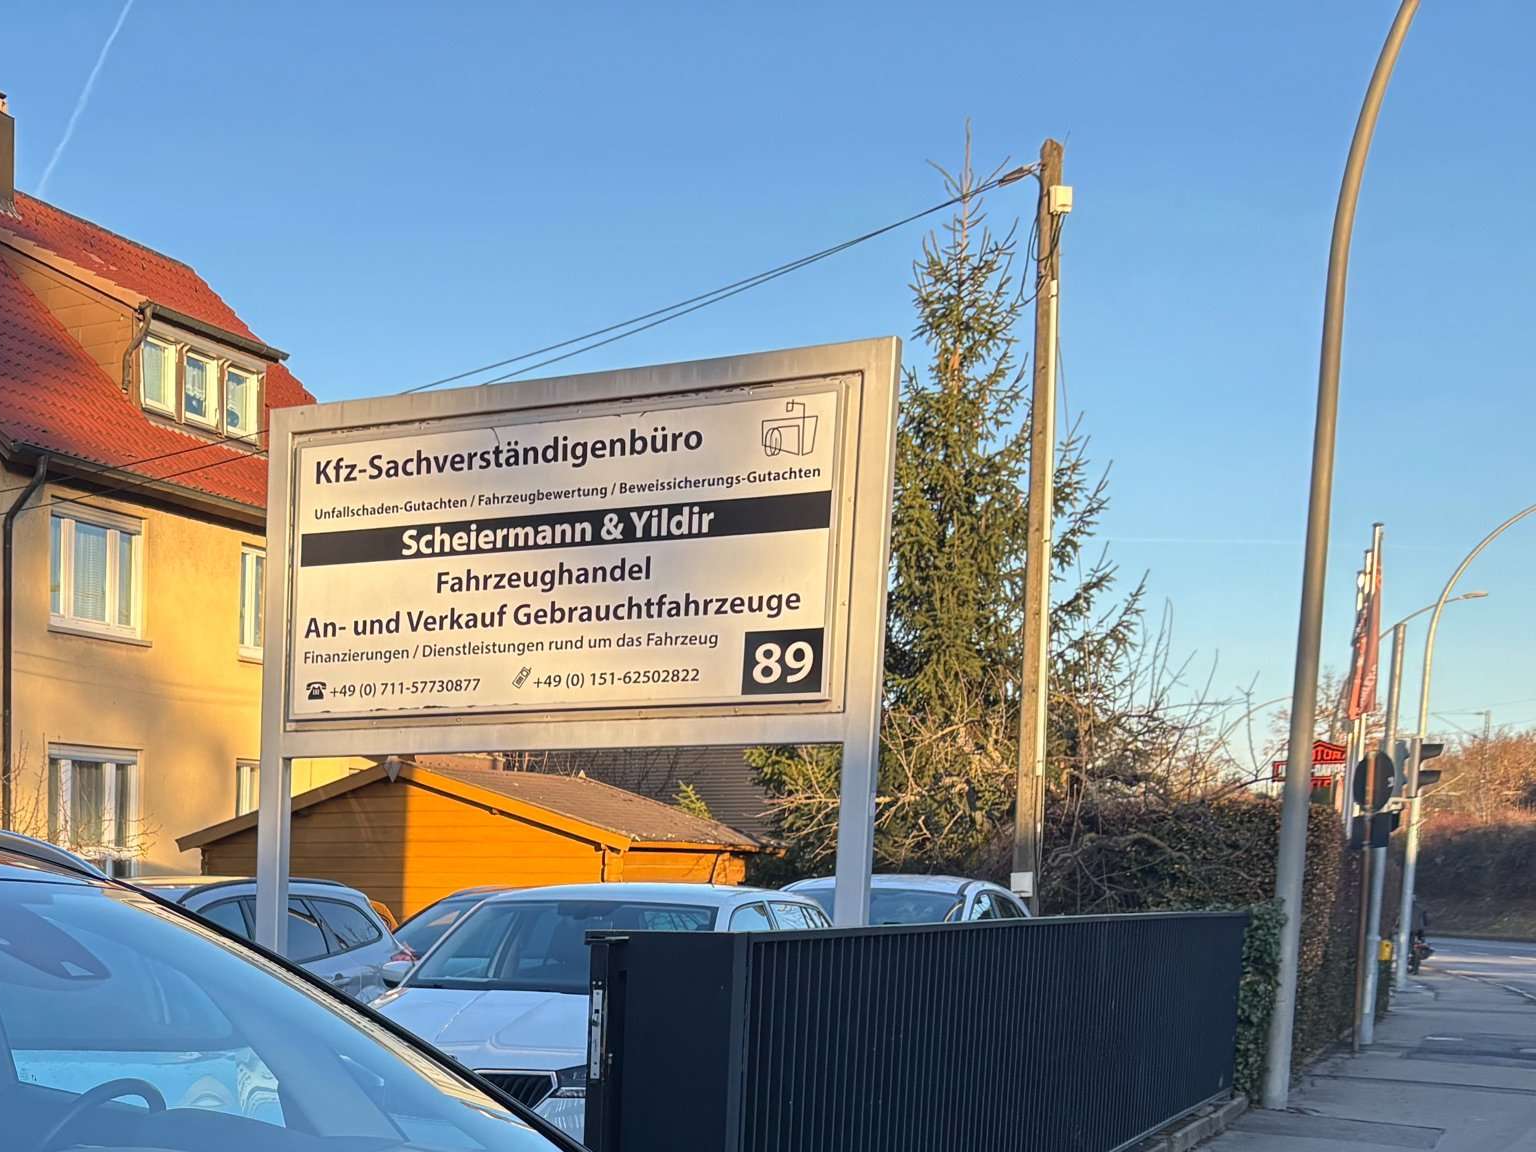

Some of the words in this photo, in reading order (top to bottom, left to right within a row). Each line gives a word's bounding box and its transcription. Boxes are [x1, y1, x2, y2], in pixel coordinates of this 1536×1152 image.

[315, 427, 703, 485] Kfz-Sachverständigenbüro
[315, 497, 467, 520] Unfallschaden-Gutachten
[470, 495, 476, 508] /
[478, 485, 608, 507] Fahrzeugbewertung
[611, 483, 616, 496] /
[619, 467, 821, 495] Beweissicherungs-Gutachten
[401, 521, 592, 556] Scheiermann
[600, 513, 624, 540] &
[630, 505, 715, 539] Yildir
[436, 556, 651, 593] Fahrzeughandel
[304, 617, 346, 639] An-
[353, 611, 401, 636] und
[407, 603, 508, 633] Verkauf
[513, 592, 802, 626] Gebrauchtfahrzeuge
[304, 648, 409, 665] Finanzierungen
[412, 645, 419, 659] /
[422, 640, 544, 658] Dienstleistungen
[549, 636, 583, 651] rund
[588, 637, 612, 649] um
[616, 633, 642, 648] das
[647, 631, 718, 648] Fahrzeug
[752, 641, 814, 685] 89
[330, 684, 356, 698] +49
[360, 682, 377, 698] (0)
[381, 678, 481, 696] 711-57730877
[533, 674, 561, 688] +49
[566, 672, 584, 688] (0)
[590, 668, 700, 686] 151-62502822
